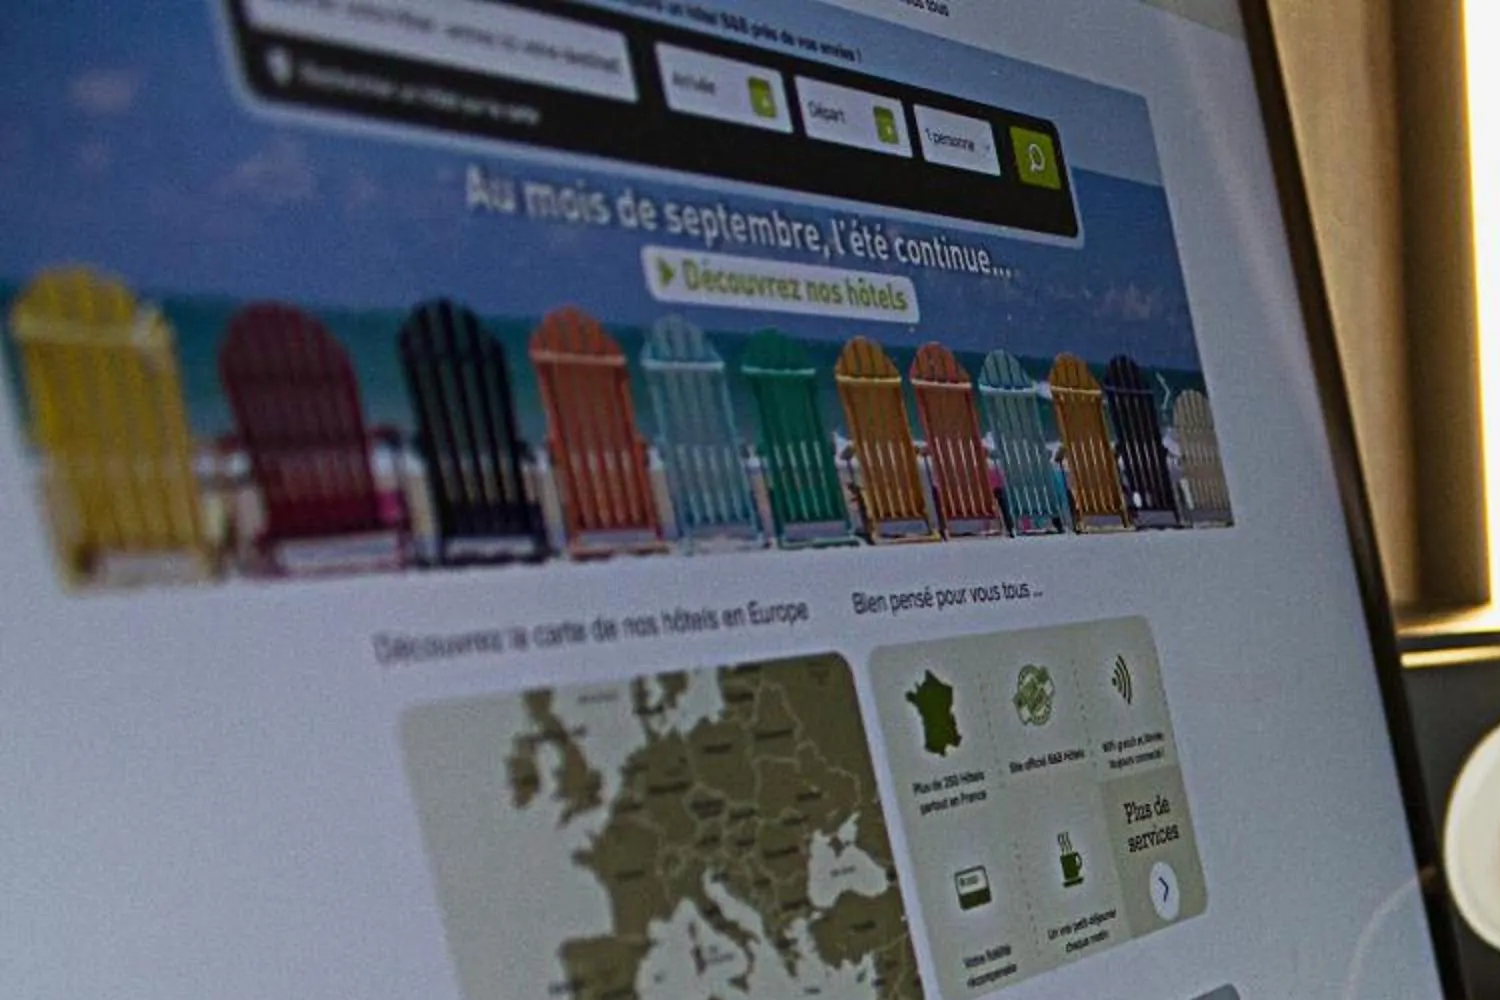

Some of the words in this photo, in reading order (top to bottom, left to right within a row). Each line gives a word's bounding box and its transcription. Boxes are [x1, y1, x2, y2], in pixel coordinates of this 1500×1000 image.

[808, 99, 846, 126] Départ
[932, 130, 976, 154] personne
[465, 163, 516, 211] Au
[523, 178, 611, 224] mois
[617, 187, 659, 231] de
[663, 202, 831, 260] septembre,
[832, 218, 890, 262] l'été
[683, 259, 800, 302] Découvrez
[806, 279, 844, 307] nos
[848, 276, 908, 313] hôtels
[852, 590, 888, 615] Bien
[890, 585, 935, 617] pensé
[937, 587, 968, 612] pour
[969, 584, 1001, 603] vous
[531, 617, 586, 649] carte
[591, 616, 619, 643] de
[622, 614, 659, 639] nos
[662, 605, 719, 635] hôtels
[721, 606, 746, 629] en
[747, 599, 810, 628] Europe
[960, 789, 987, 804] France
[1123, 800, 1153, 824] Plus
[1153, 794, 1171, 816] de
[1127, 823, 1180, 853] services
